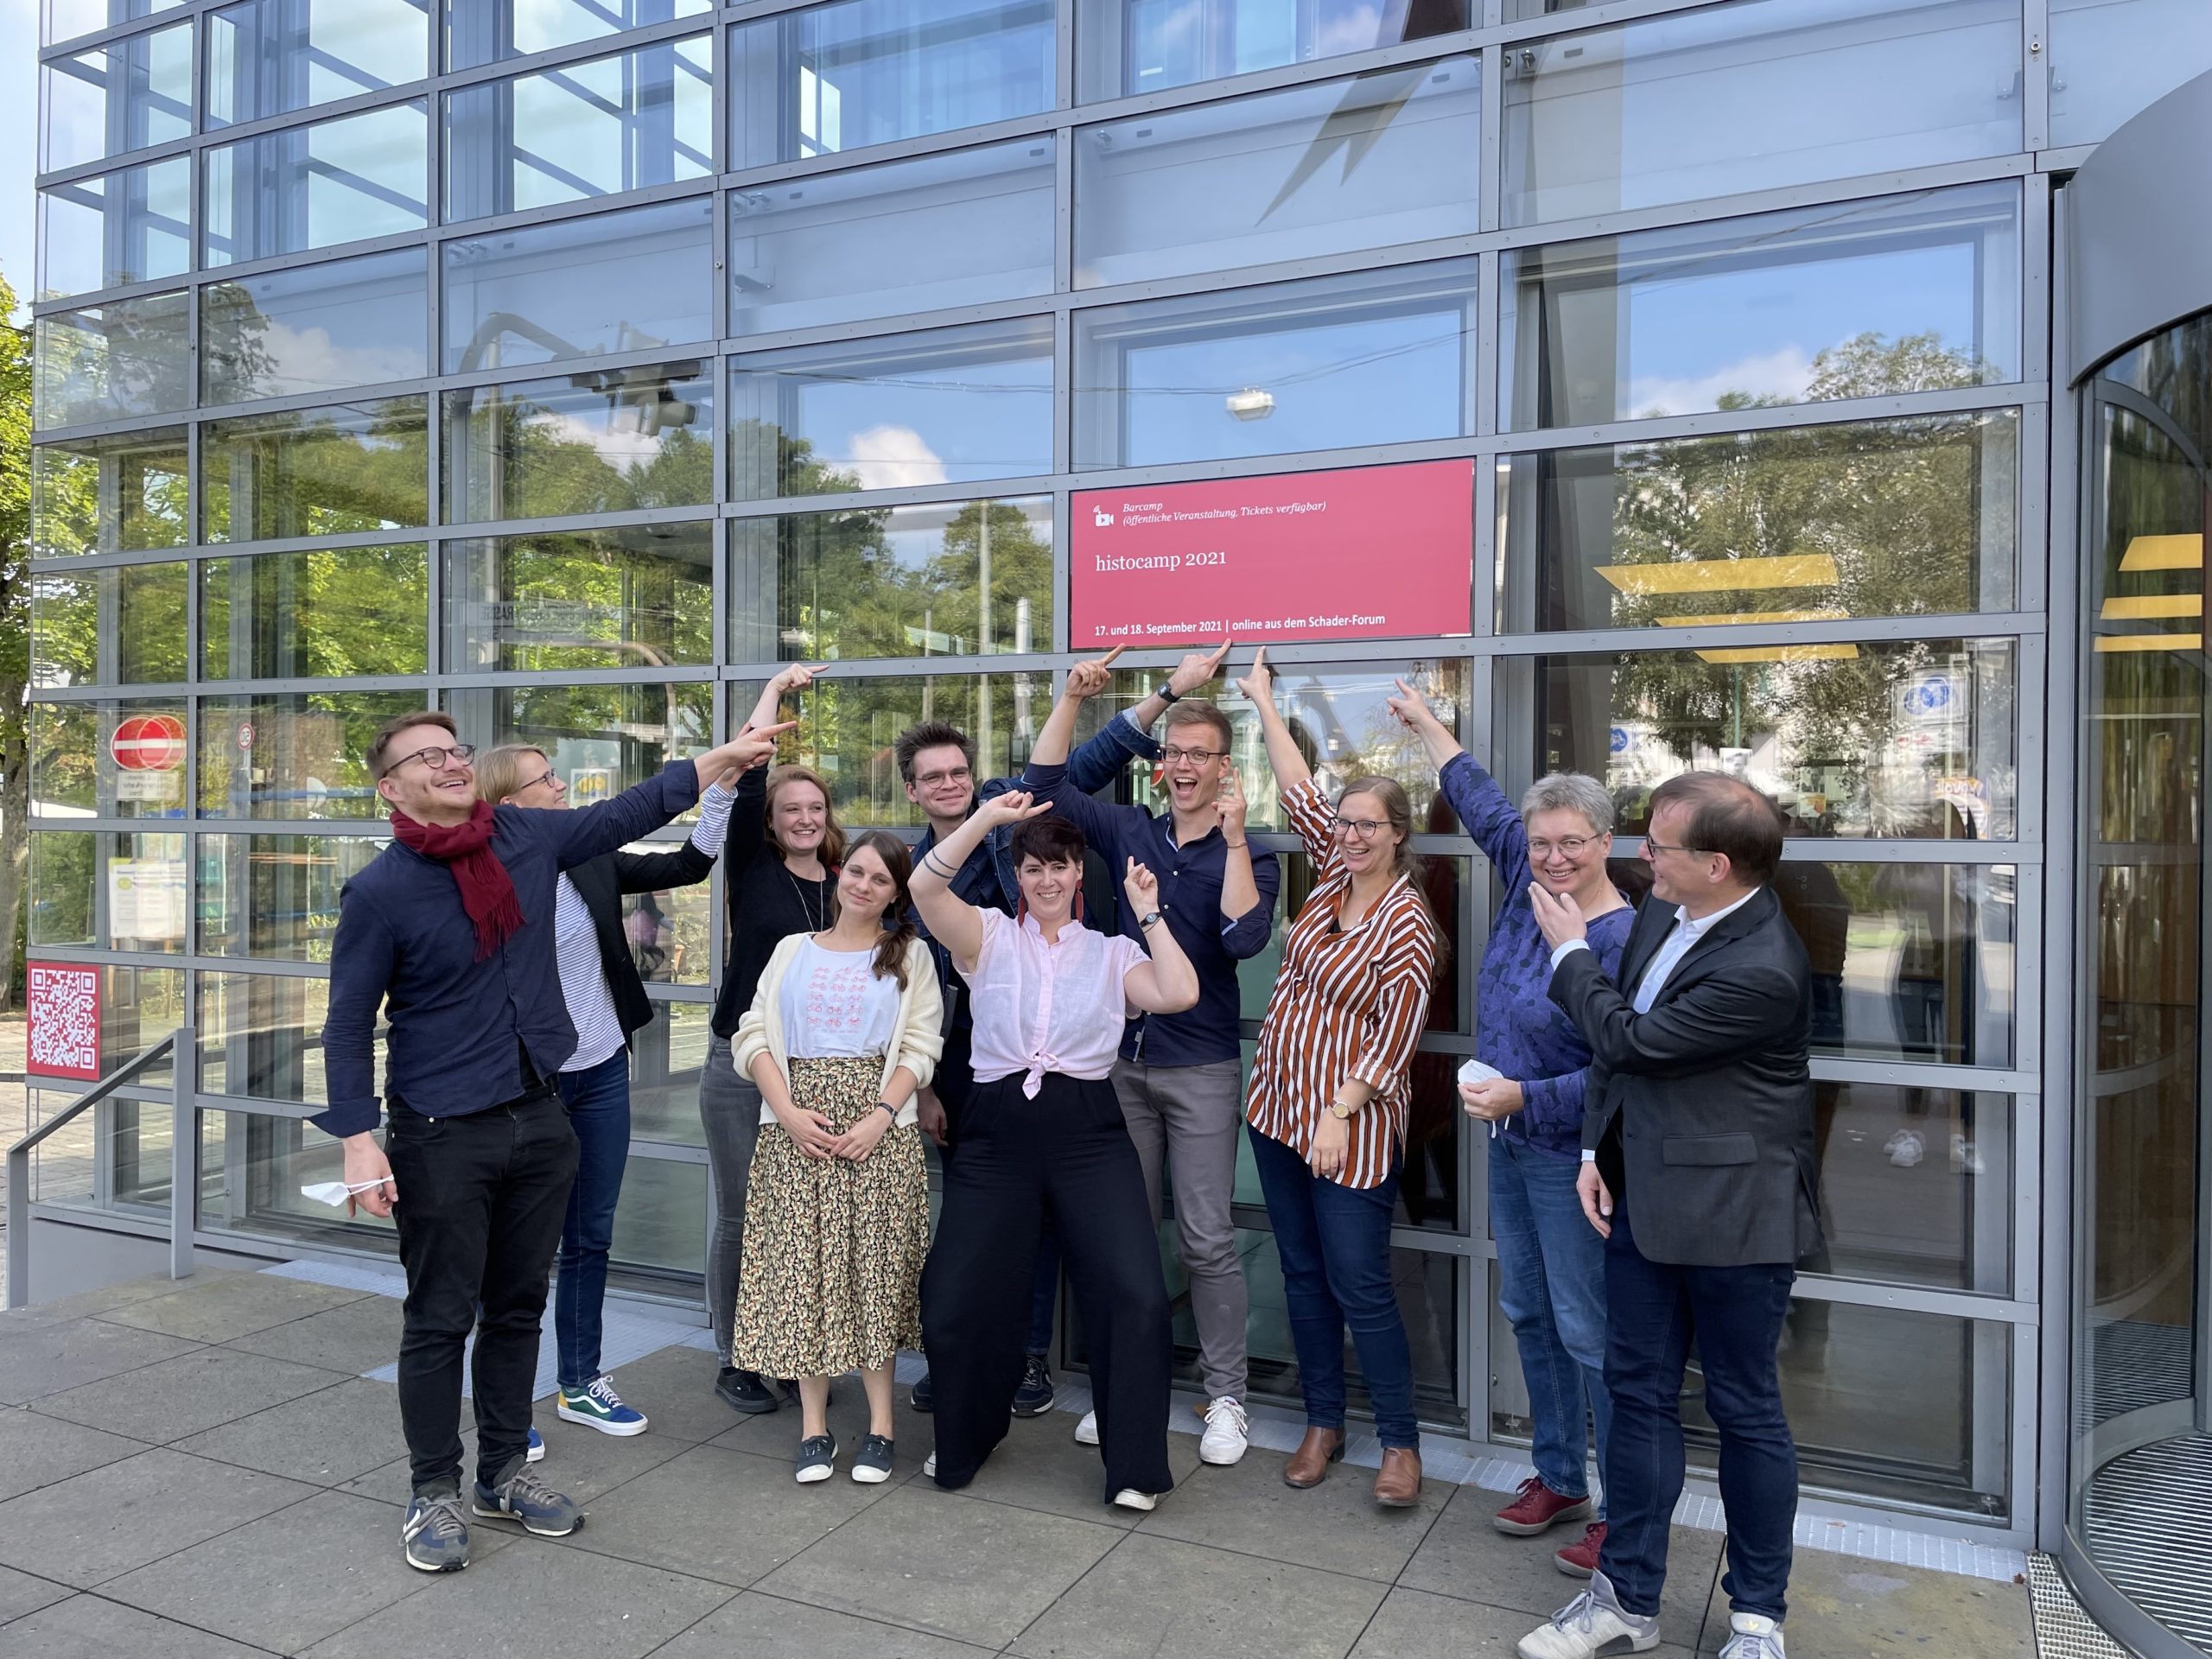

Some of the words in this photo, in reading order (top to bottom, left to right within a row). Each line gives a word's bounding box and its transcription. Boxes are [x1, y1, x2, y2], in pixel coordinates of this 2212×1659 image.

[1122, 513, 1173, 526] (öffentliche
[1174, 509, 1238, 521] Veranstaltung,
[1241, 505, 1274, 517] Tickets
[1276, 501, 1326, 515] verfügbar)
[1123, 503, 1163, 513] Barcamp
[1095, 554, 1181, 572] histocamp
[1185, 551, 1227, 567] 2021
[1095, 625, 1109, 636] 17.
[1110, 624, 1128, 636] und
[1130, 624, 1144, 635] 18.
[1146, 622, 1198, 636] September
[1198, 620, 1222, 632] 2021
[1232, 618, 1263, 632] online
[1264, 620, 1282, 630] aus
[1284, 617, 1306, 629] dem
[1308, 614, 1386, 628] Schader-Forum
